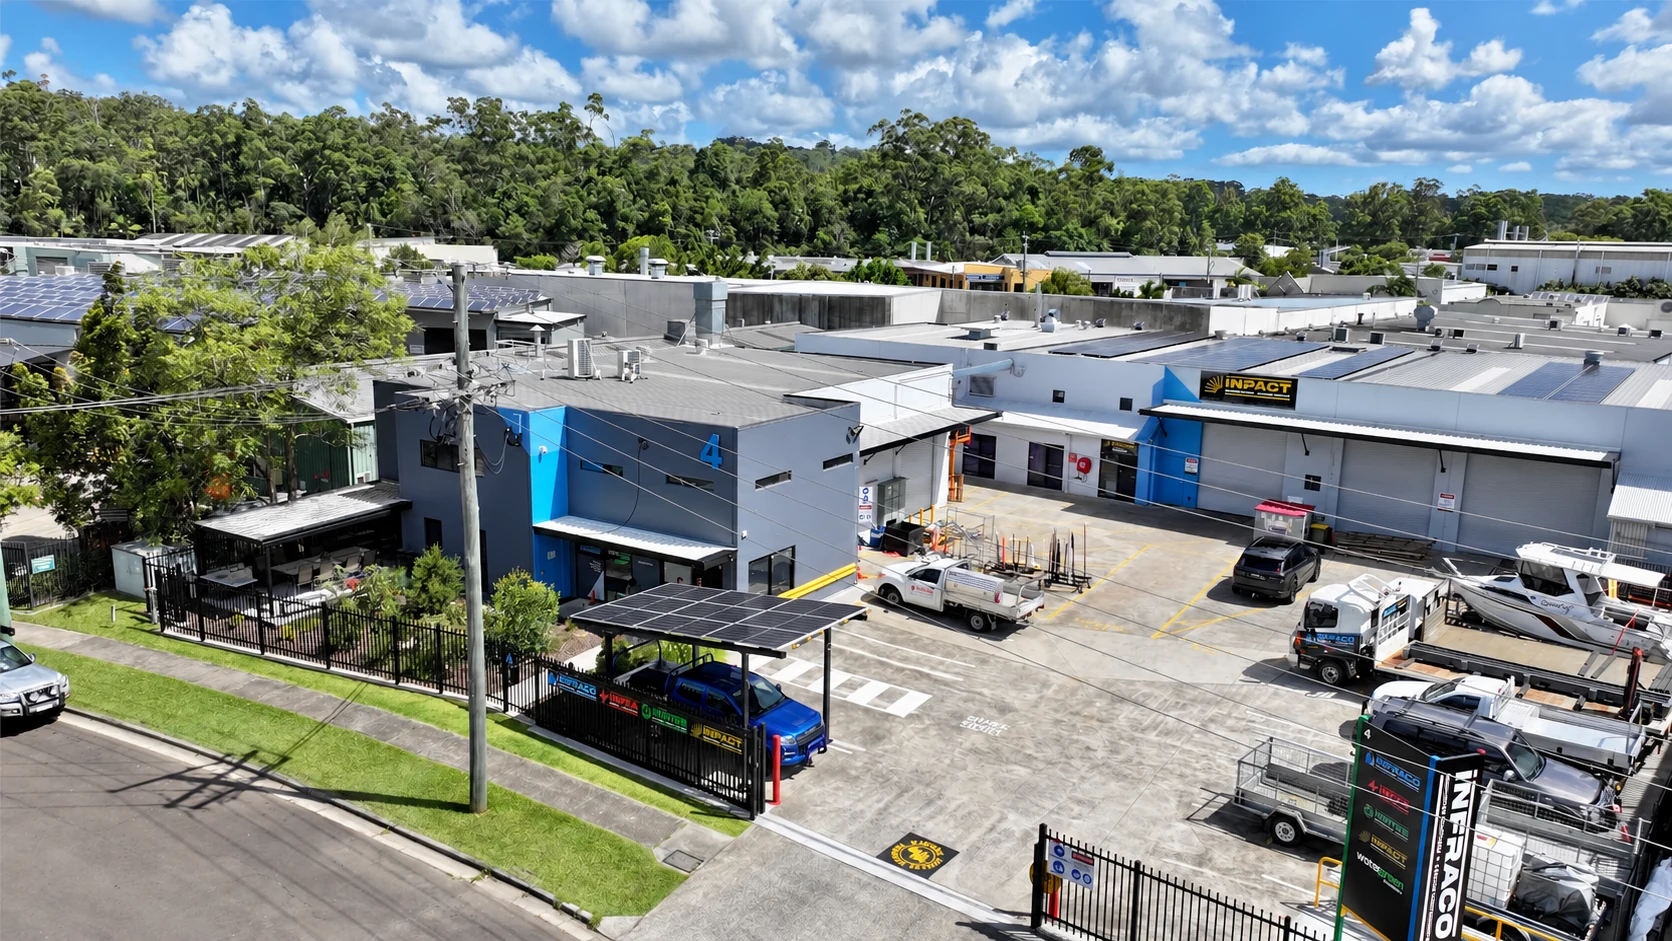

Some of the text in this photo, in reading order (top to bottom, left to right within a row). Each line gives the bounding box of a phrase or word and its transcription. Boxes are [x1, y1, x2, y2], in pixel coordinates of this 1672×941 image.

[1225, 378, 1291, 394] INPACT
[700, 433, 722, 469] 4
[1364, 728, 1371, 740] 4
